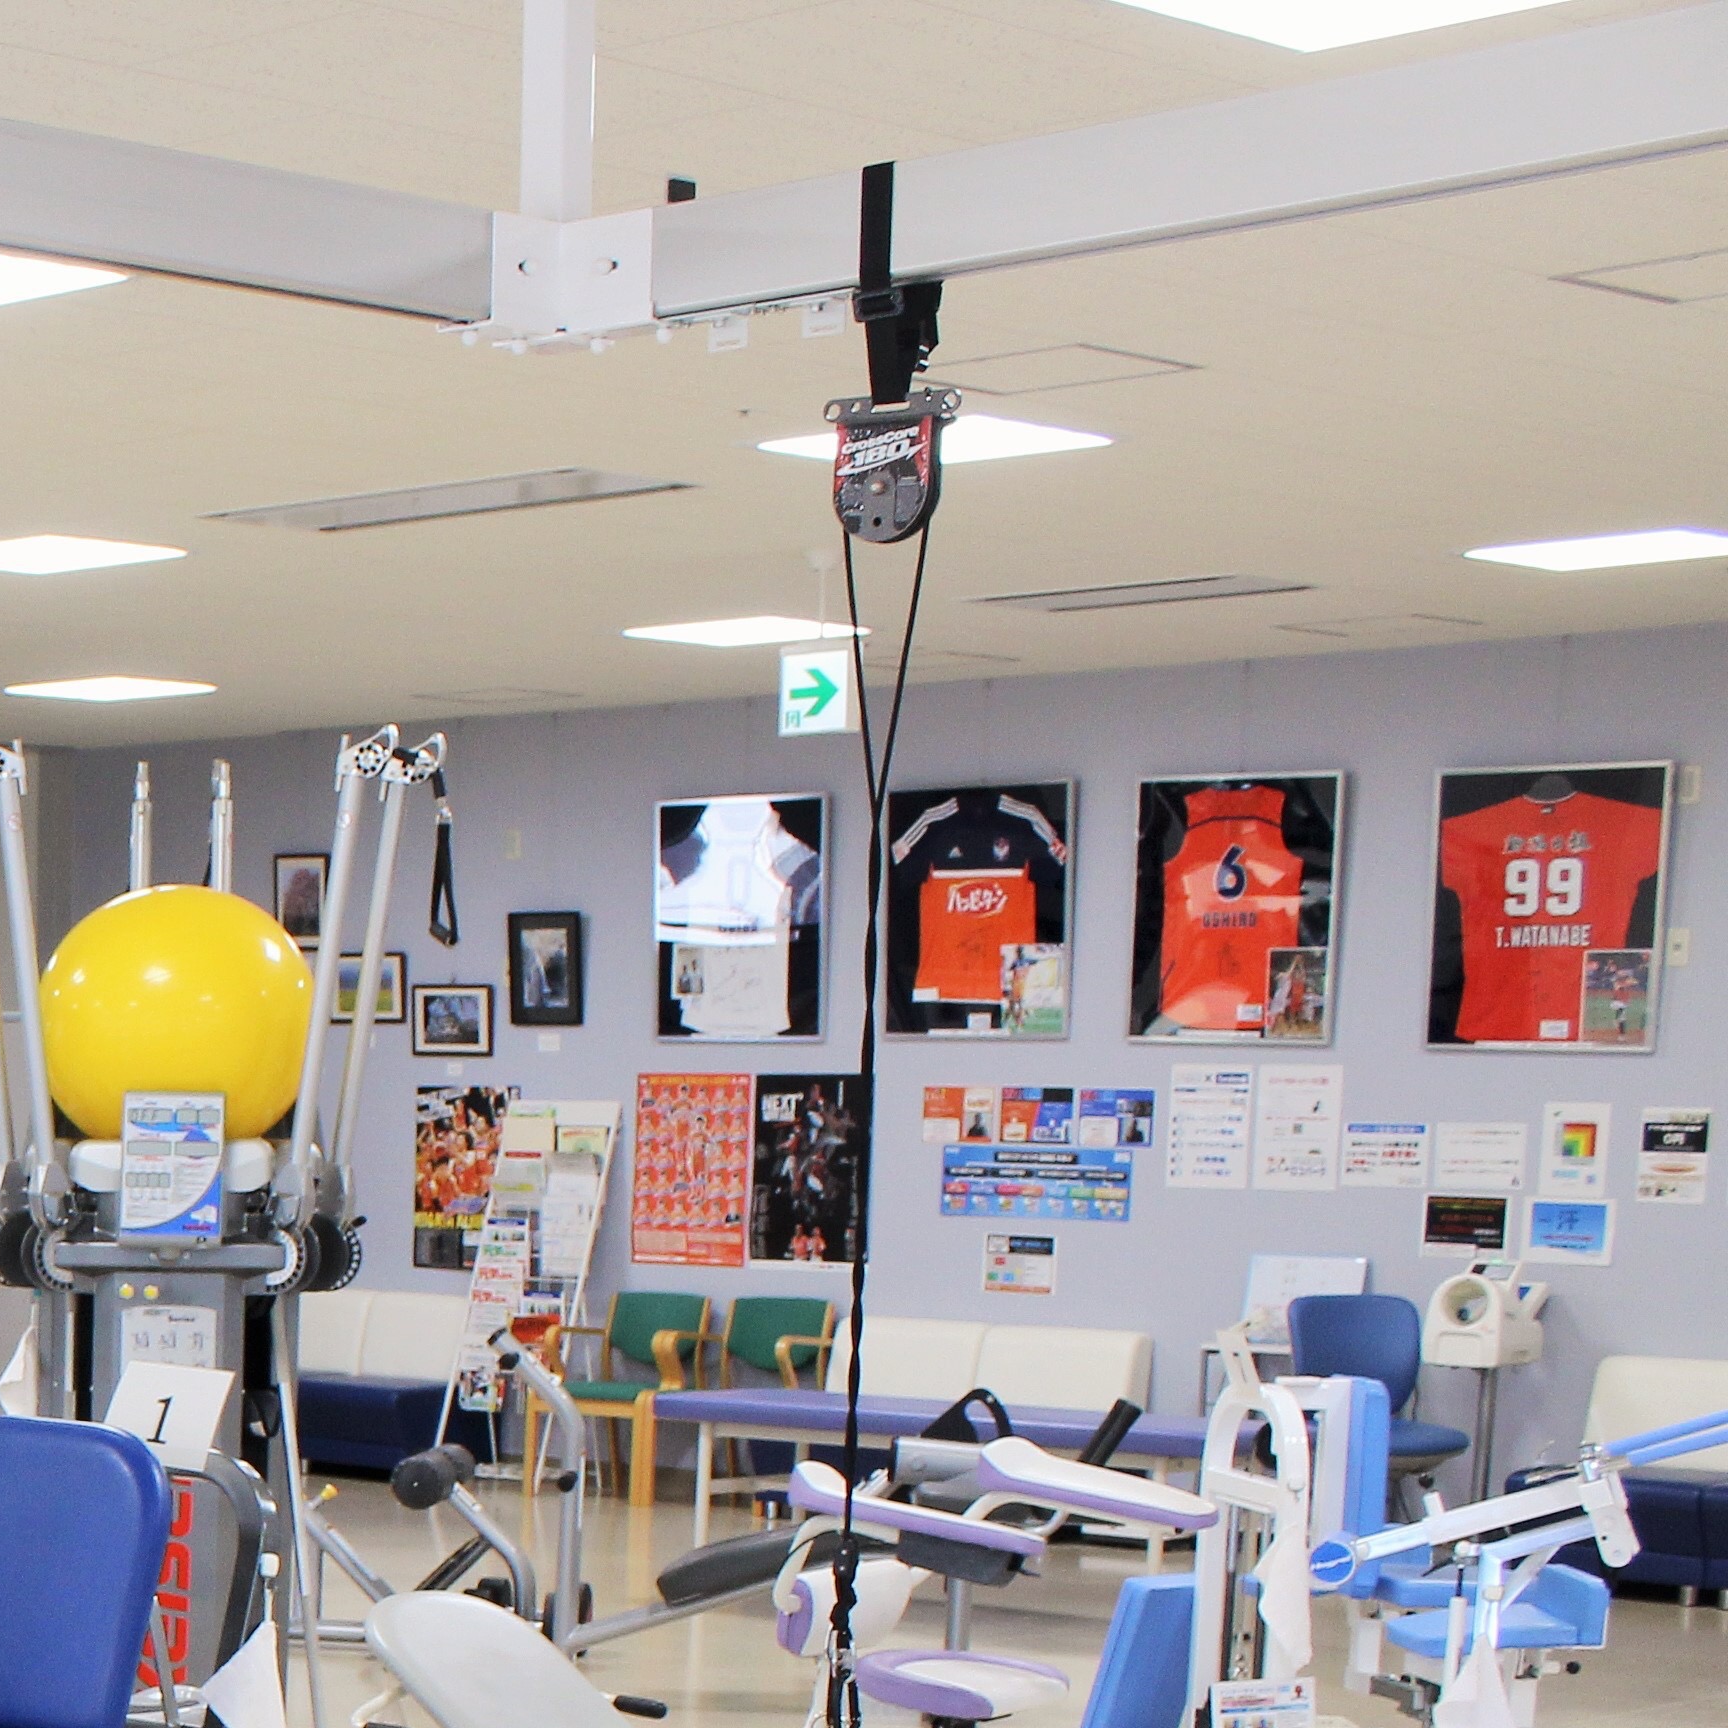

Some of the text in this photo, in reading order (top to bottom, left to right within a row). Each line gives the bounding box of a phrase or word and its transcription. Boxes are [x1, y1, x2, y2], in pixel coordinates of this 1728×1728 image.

[854, 439, 911, 467] 180
[1215, 845, 1247, 901] 6
[1503, 857, 1584, 916] 99
[1495, 923, 1592, 949] T.WATANABE
[146, 1395, 176, 1445] 1
